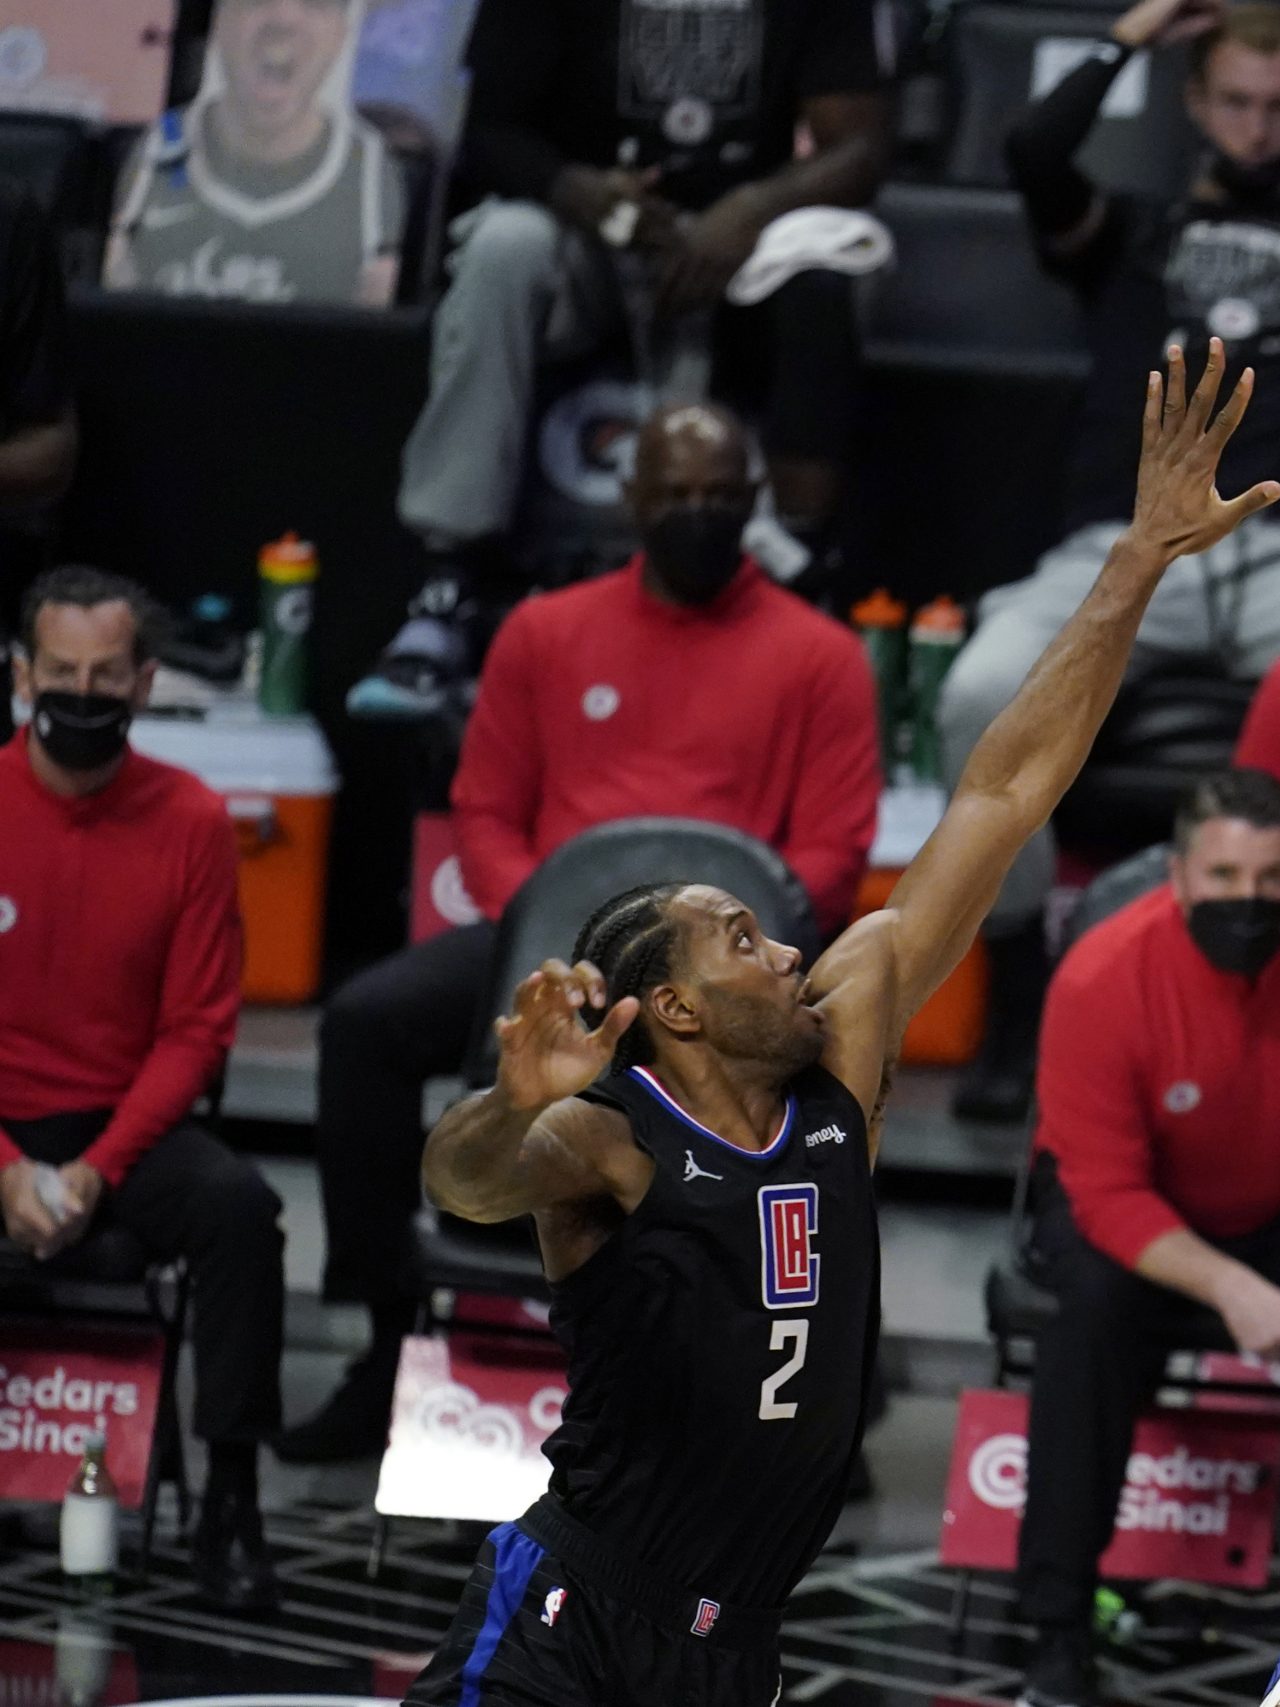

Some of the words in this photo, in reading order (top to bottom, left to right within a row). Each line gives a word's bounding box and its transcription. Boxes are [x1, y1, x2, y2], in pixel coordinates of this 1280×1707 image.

[0, 1366, 138, 1416] edars
[758, 1318, 809, 1421] 2
[1125, 1447, 1257, 1494] edars
